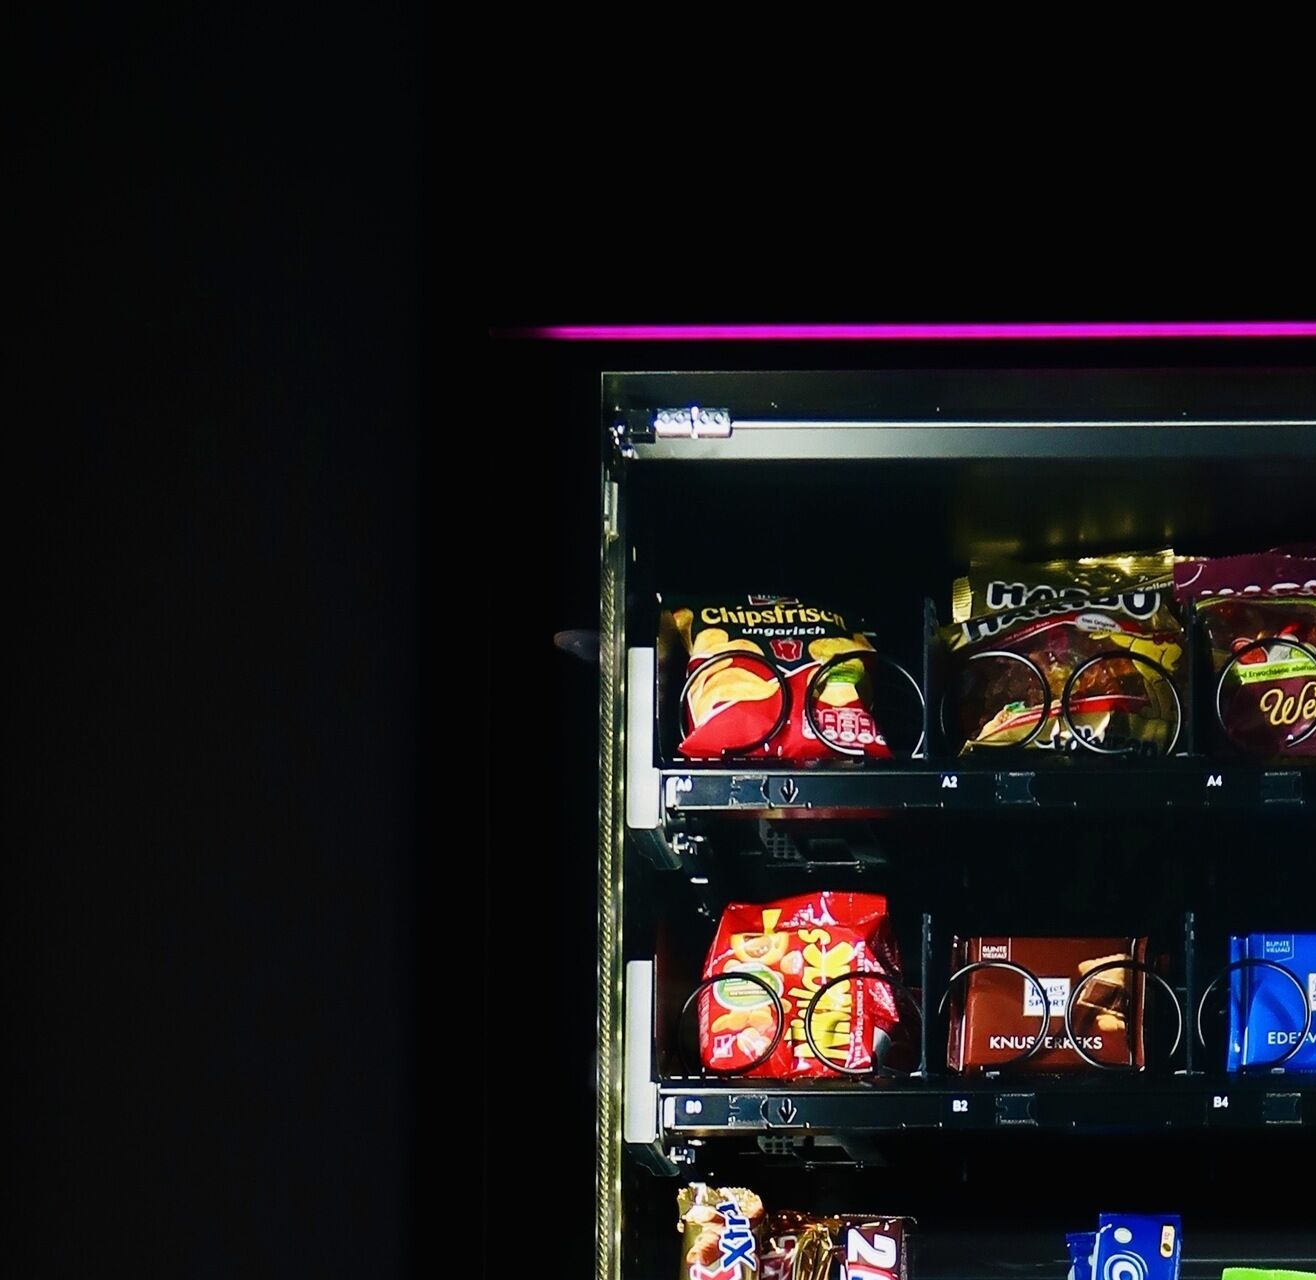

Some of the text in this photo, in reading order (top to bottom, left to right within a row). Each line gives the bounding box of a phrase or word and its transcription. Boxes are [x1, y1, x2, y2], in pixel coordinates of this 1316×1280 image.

[742, 625, 825, 637] ungarisch
[942, 776, 958, 788] A2
[1207, 775, 1222, 787] A4
[953, 1100, 968, 1112] B2
[1213, 1096, 1229, 1108] B4
[848, 1228, 898, 1269] 2
